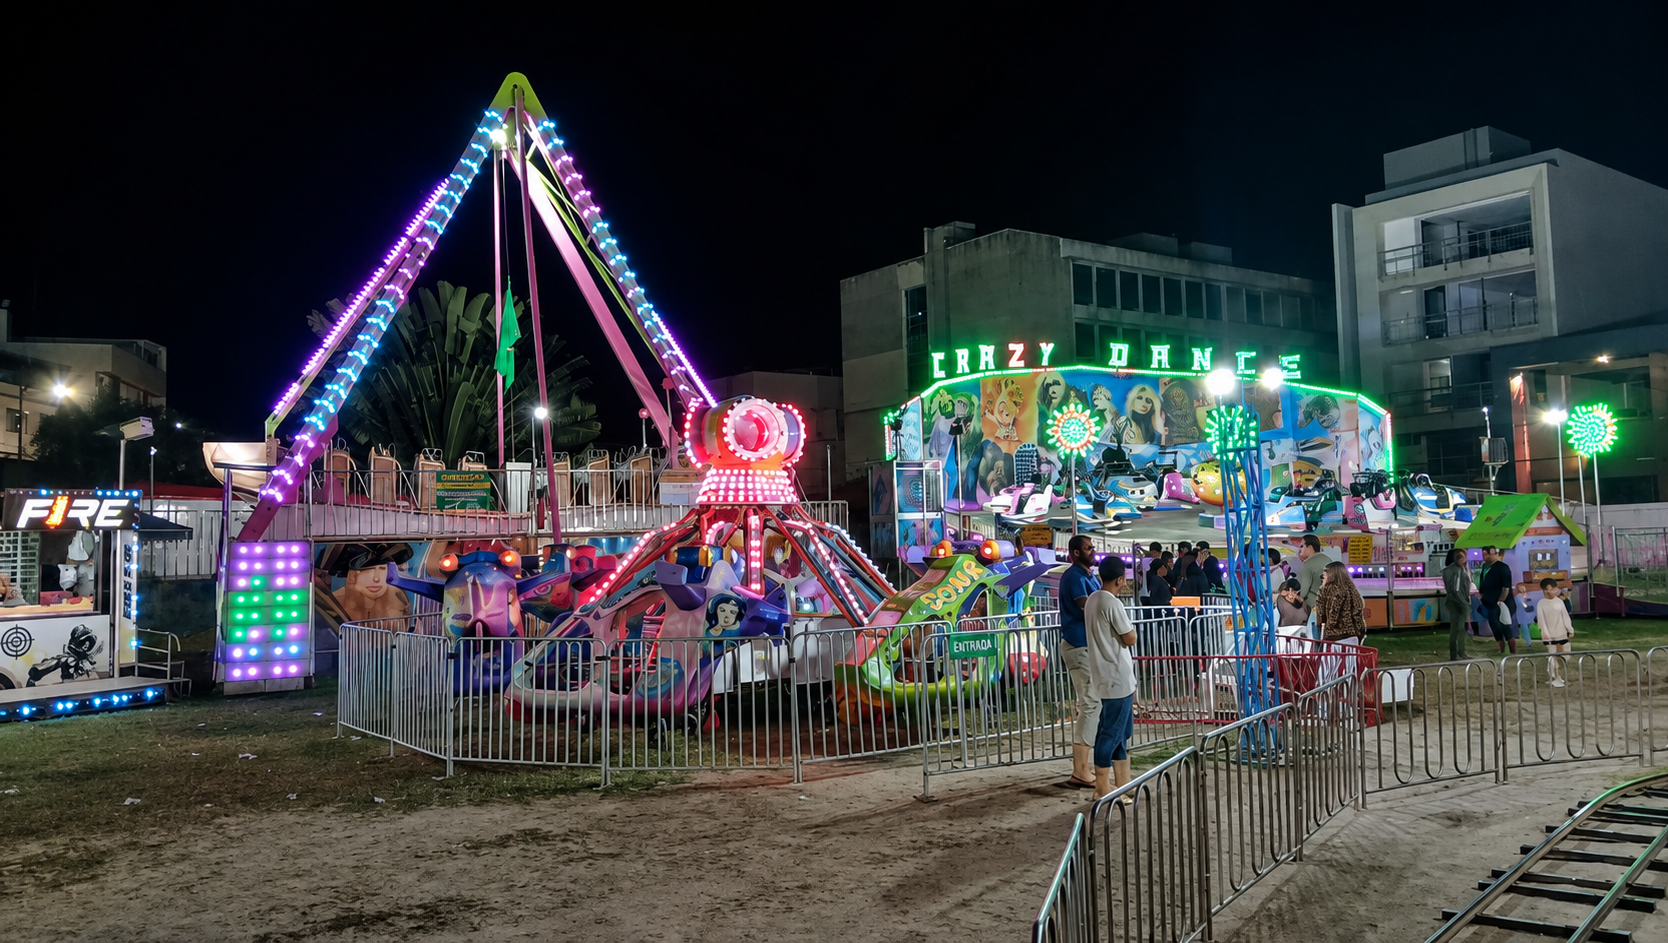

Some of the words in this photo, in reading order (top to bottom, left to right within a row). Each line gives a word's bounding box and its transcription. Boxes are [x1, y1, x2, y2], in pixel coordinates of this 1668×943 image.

[931, 342, 1055, 379] CRAZY
[1108, 342, 1302, 380] DANCE
[16, 496, 130, 529] FIRE
